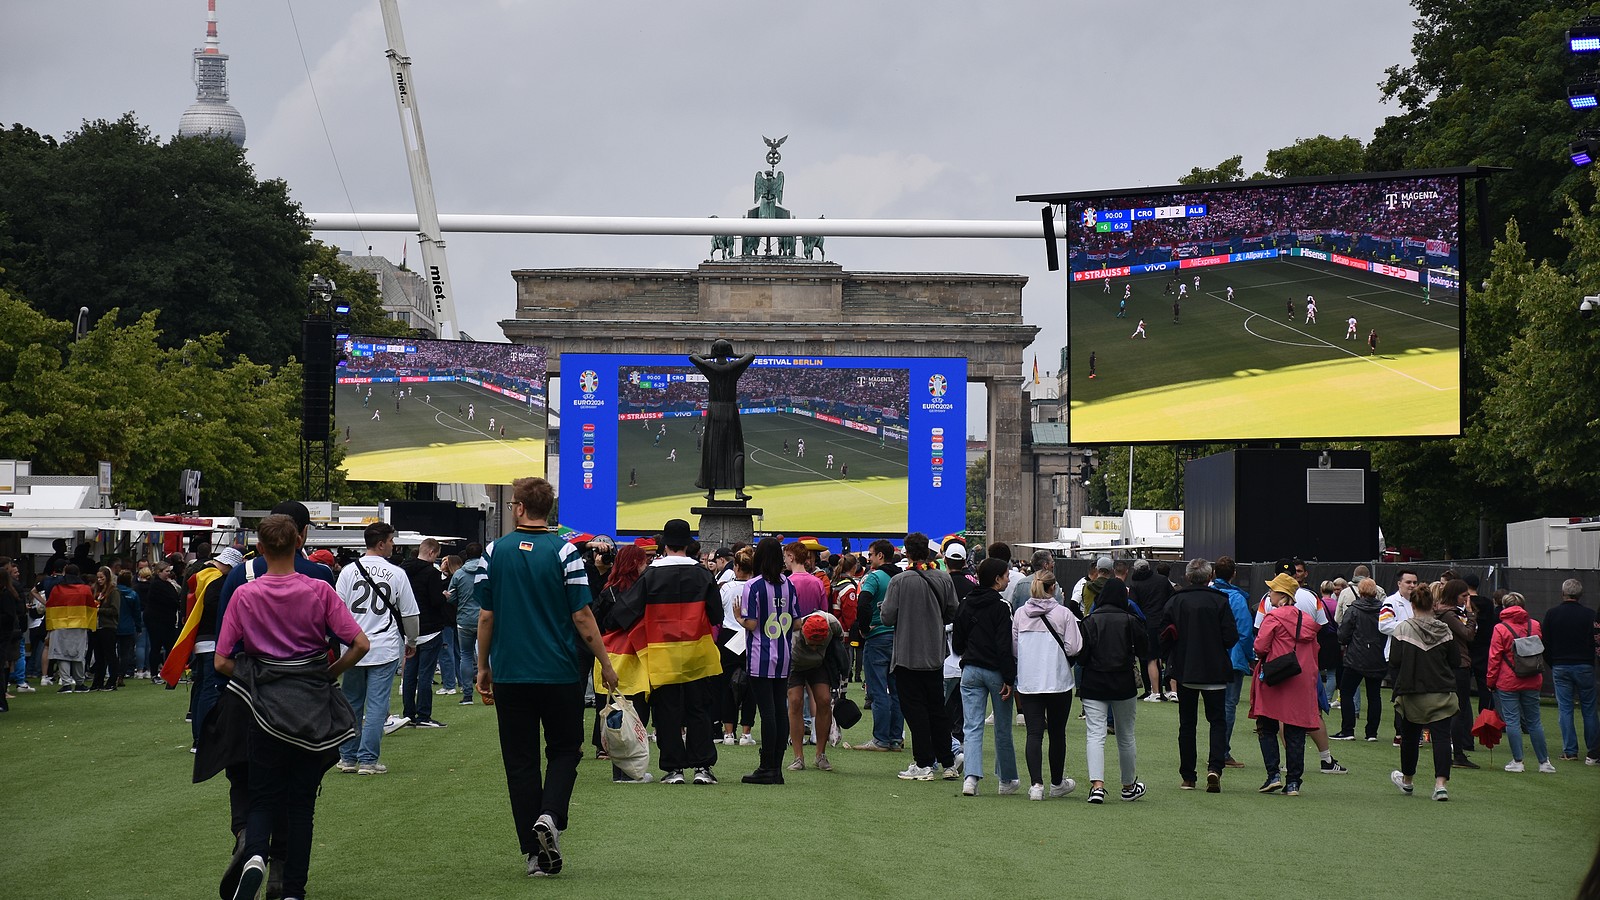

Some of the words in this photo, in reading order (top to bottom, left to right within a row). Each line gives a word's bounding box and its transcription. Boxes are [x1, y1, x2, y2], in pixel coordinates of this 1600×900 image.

[396, 72, 408, 104] miet...
[1401, 191, 1439, 201] MAGENTA
[1401, 201, 1412, 209] TV
[1137, 209, 1153, 217] CRO
[1114, 222, 1128, 230] 6:29
[1300, 247, 1327, 261] Hisense
[1084, 268, 1122, 280] STRAUSS
[429, 265, 447, 313] miet...
[752, 358, 792, 366] FESTIVAL
[351, 580, 391, 615] 20
[772, 597, 787, 608] EIS
[764, 612, 793, 639] 69
